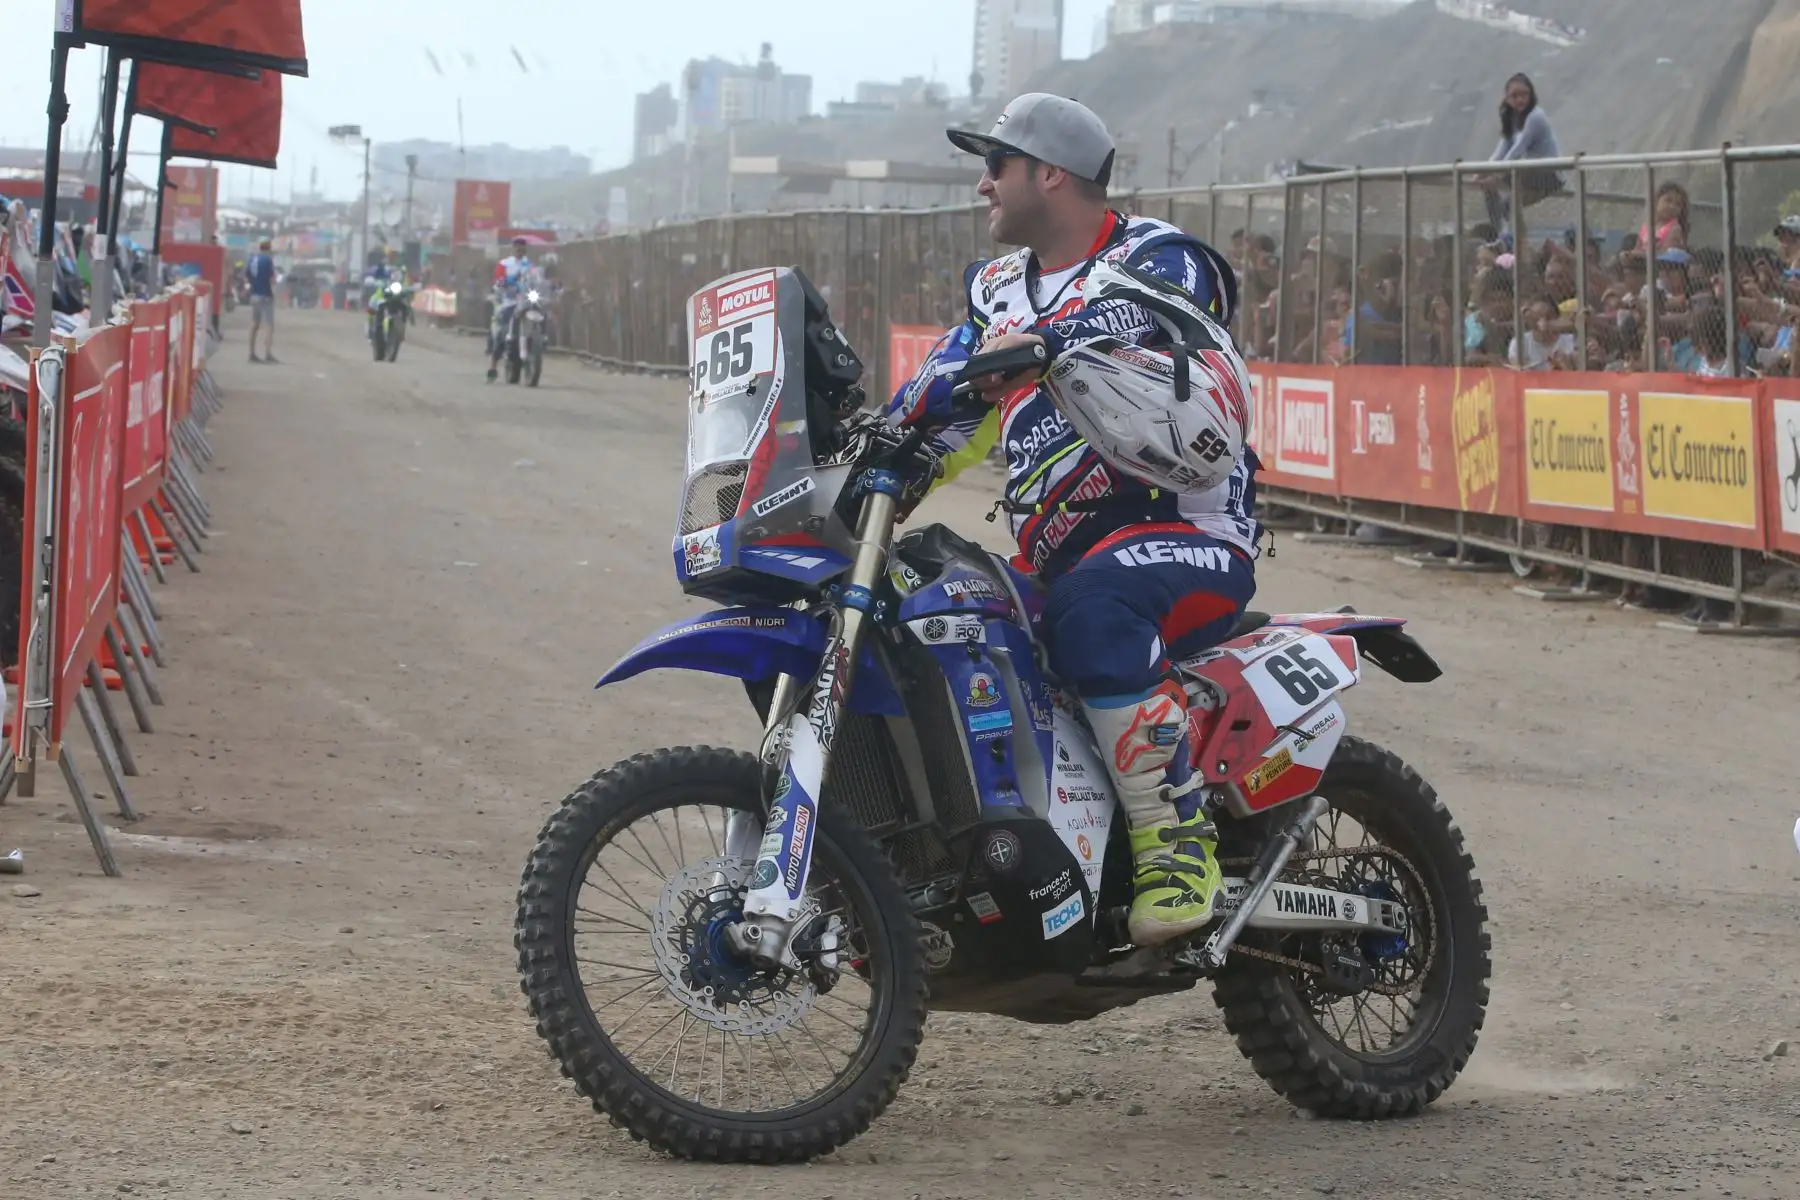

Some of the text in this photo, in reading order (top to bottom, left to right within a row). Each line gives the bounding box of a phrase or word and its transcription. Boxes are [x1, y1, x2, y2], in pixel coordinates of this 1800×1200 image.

[721, 285, 770, 313] MOTUL
[1283, 399, 1328, 456] MOTUL
[1530, 418, 1545, 470] El
[1647, 424, 1668, 480] El
[1669, 425, 1748, 489] Comercio
[757, 479, 810, 515] KENNY
[1045, 467, 1111, 549] PULION
[1113, 541, 1232, 573] KENNY
[957, 627, 982, 639] ROY
[1264, 644, 1340, 706] 65
[1293, 713, 1336, 747] ROVREAU
[785, 806, 809, 891] MOTO PULSION
[1052, 878, 1072, 900] sport
[1272, 889, 1337, 918] YAMAHA
